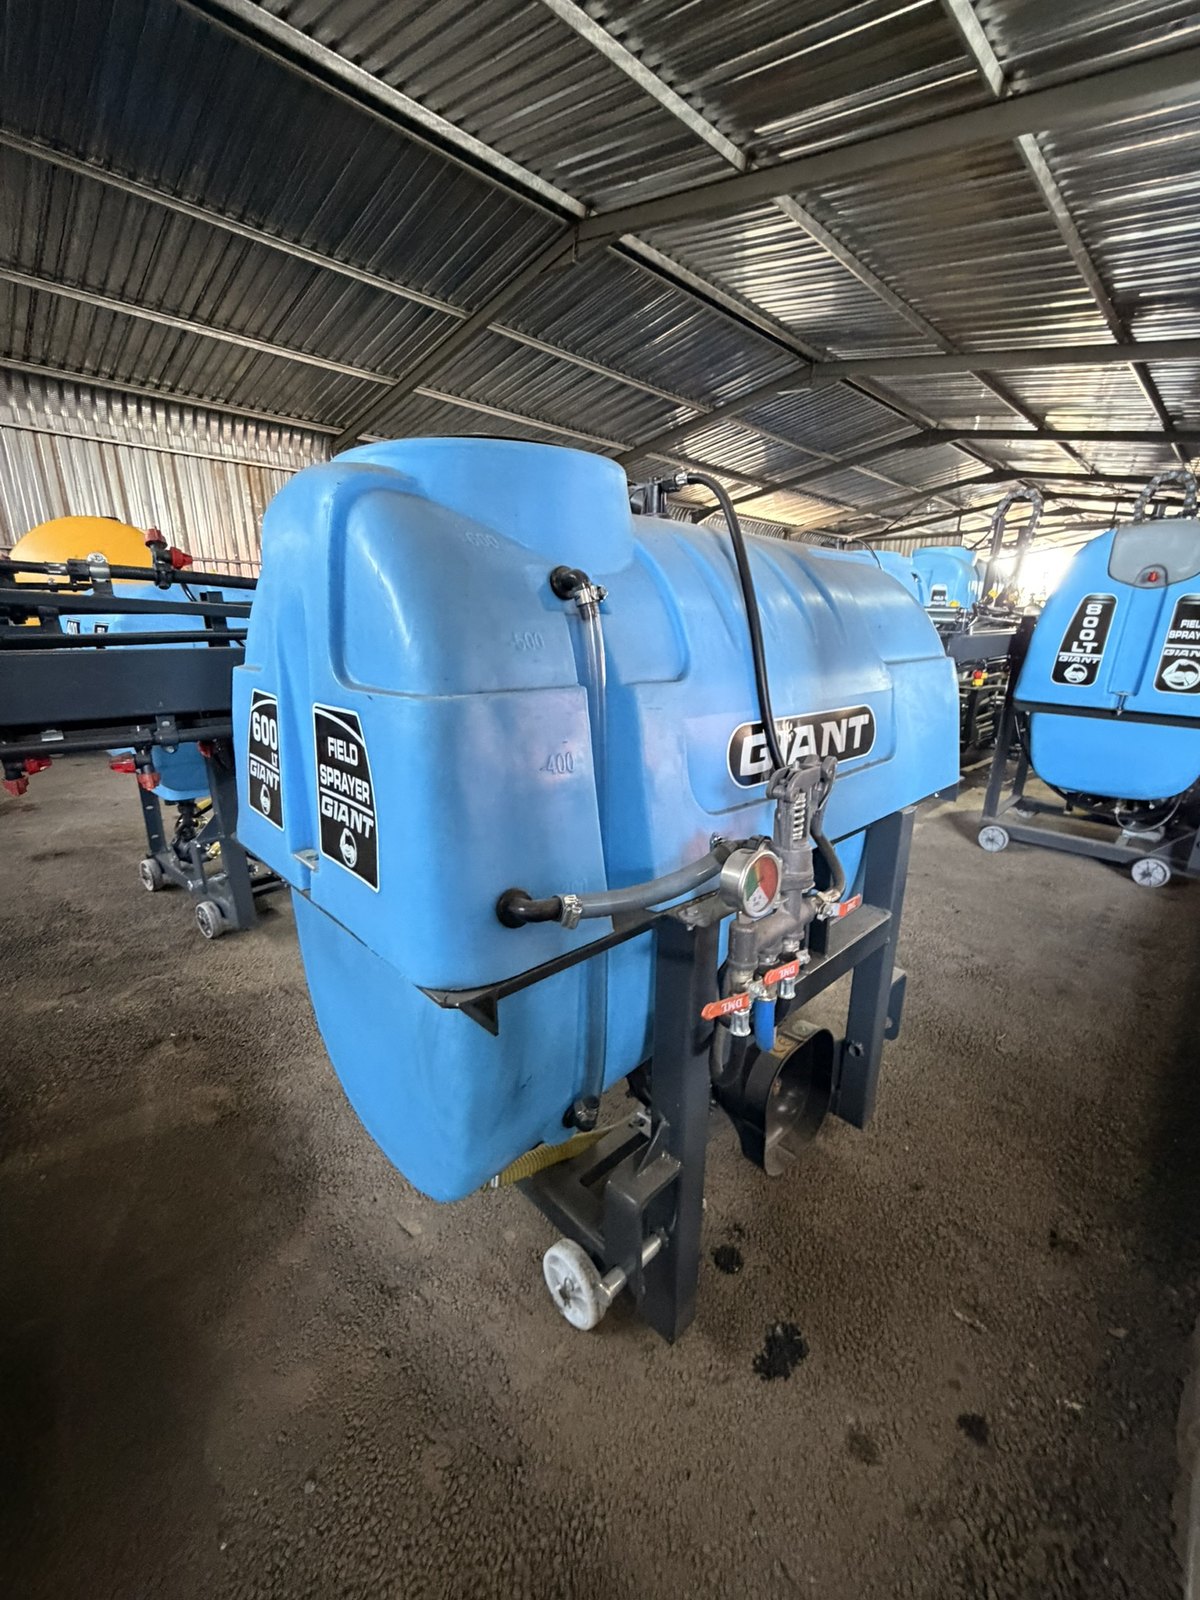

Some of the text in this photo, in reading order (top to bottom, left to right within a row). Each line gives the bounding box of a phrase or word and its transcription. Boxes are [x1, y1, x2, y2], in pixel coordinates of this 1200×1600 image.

[1058, 655, 1101, 664] GIANT
[252, 711, 278, 751] 600
[270, 751, 278, 767] LT
[327, 736, 359, 767] FIELD
[250, 759, 280, 792] GIANT
[319, 763, 371, 805] SPRAYER
[321, 795, 374, 839] GIANT
